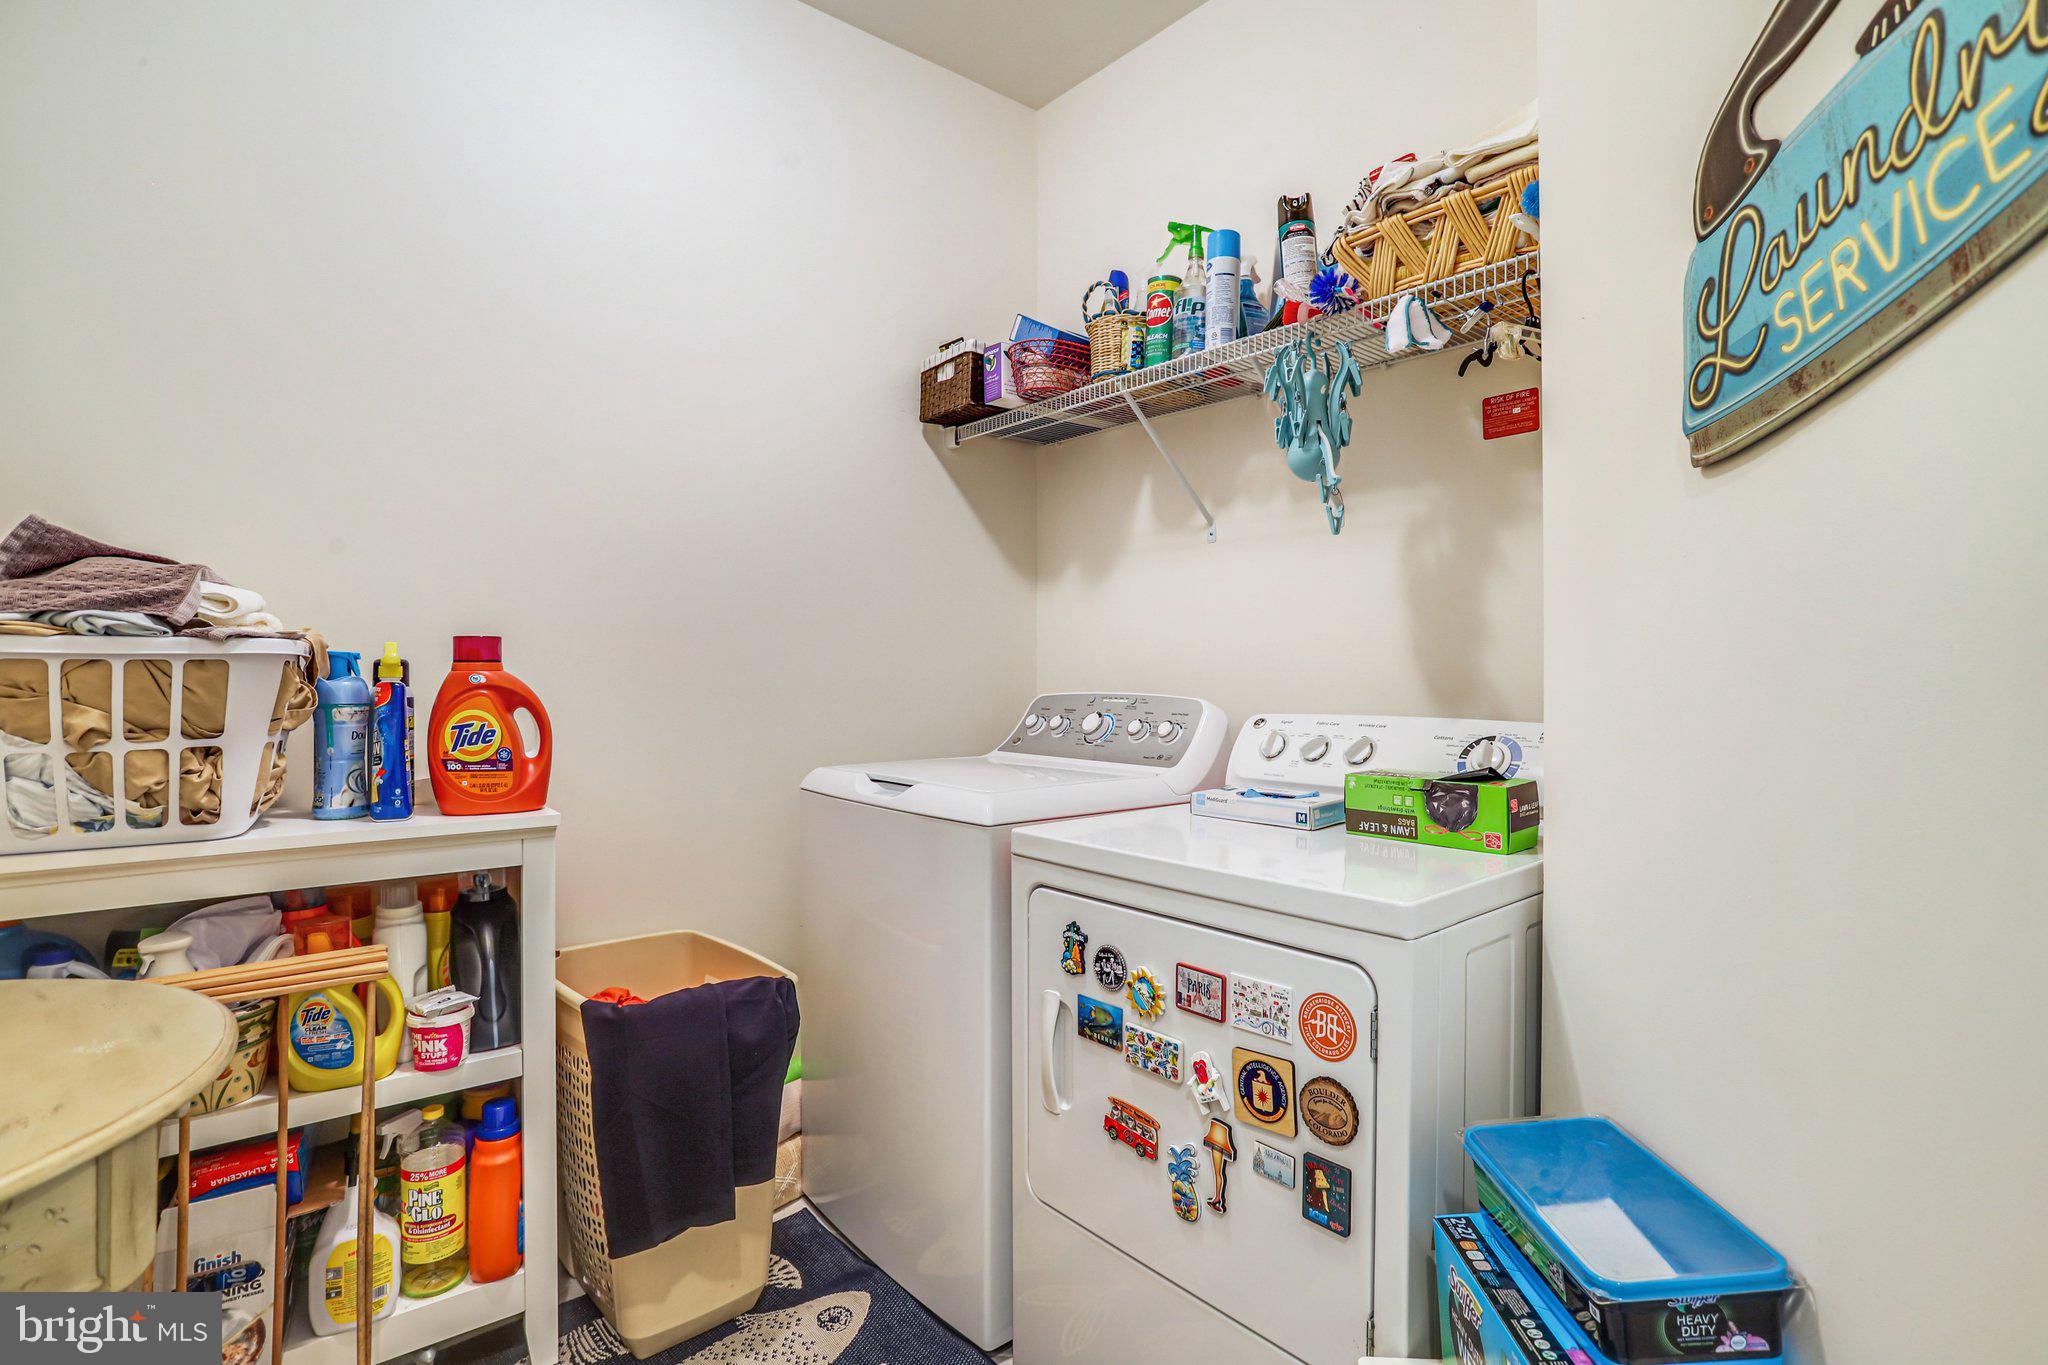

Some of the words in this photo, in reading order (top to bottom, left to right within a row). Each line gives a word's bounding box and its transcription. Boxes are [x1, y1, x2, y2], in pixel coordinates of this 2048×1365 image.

[1773, 84, 2032, 353] SERVICE
[1490, 396, 1504, 404] RISK
[1506, 393, 1514, 401] OF
[1516, 390, 1530, 398] FIRE
[450, 722, 497, 752] Tide
[1298, 814, 1306, 823] M
[1359, 821, 1380, 831] LEAF
[1398, 818, 1416, 826] BAGS
[1382, 824, 1388, 832] &
[1390, 825, 1416, 837] LAWN
[1188, 978, 1210, 1000] PARIS
[301, 1006, 331, 1026] Tide
[1336, 1005, 1351, 1034] BREWERY
[412, 1038, 448, 1052] PINK
[1340, 1040, 1350, 1052] ALES
[421, 1050, 448, 1059] STUFF
[1246, 1062, 1279, 1080] INTELLIGENCE
[1278, 1081, 1286, 1108] AGENCY
[1308, 1088, 1346, 1106] BOULDER
[1309, 1119, 1347, 1137] COLORADO
[210, 1166, 267, 1187] ALMACENAR
[410, 1172, 428, 1182] 25%
[429, 1167, 447, 1177] MORE
[411, 1206, 443, 1222] GLO
[413, 1221, 451, 1234] Disinfectant
[193, 1250, 241, 1275] finish
[1448, 1264, 1483, 1330] Swiffer
[1677, 1313, 1719, 1326] HEAVY
[1682, 1324, 1716, 1337] DUTY
